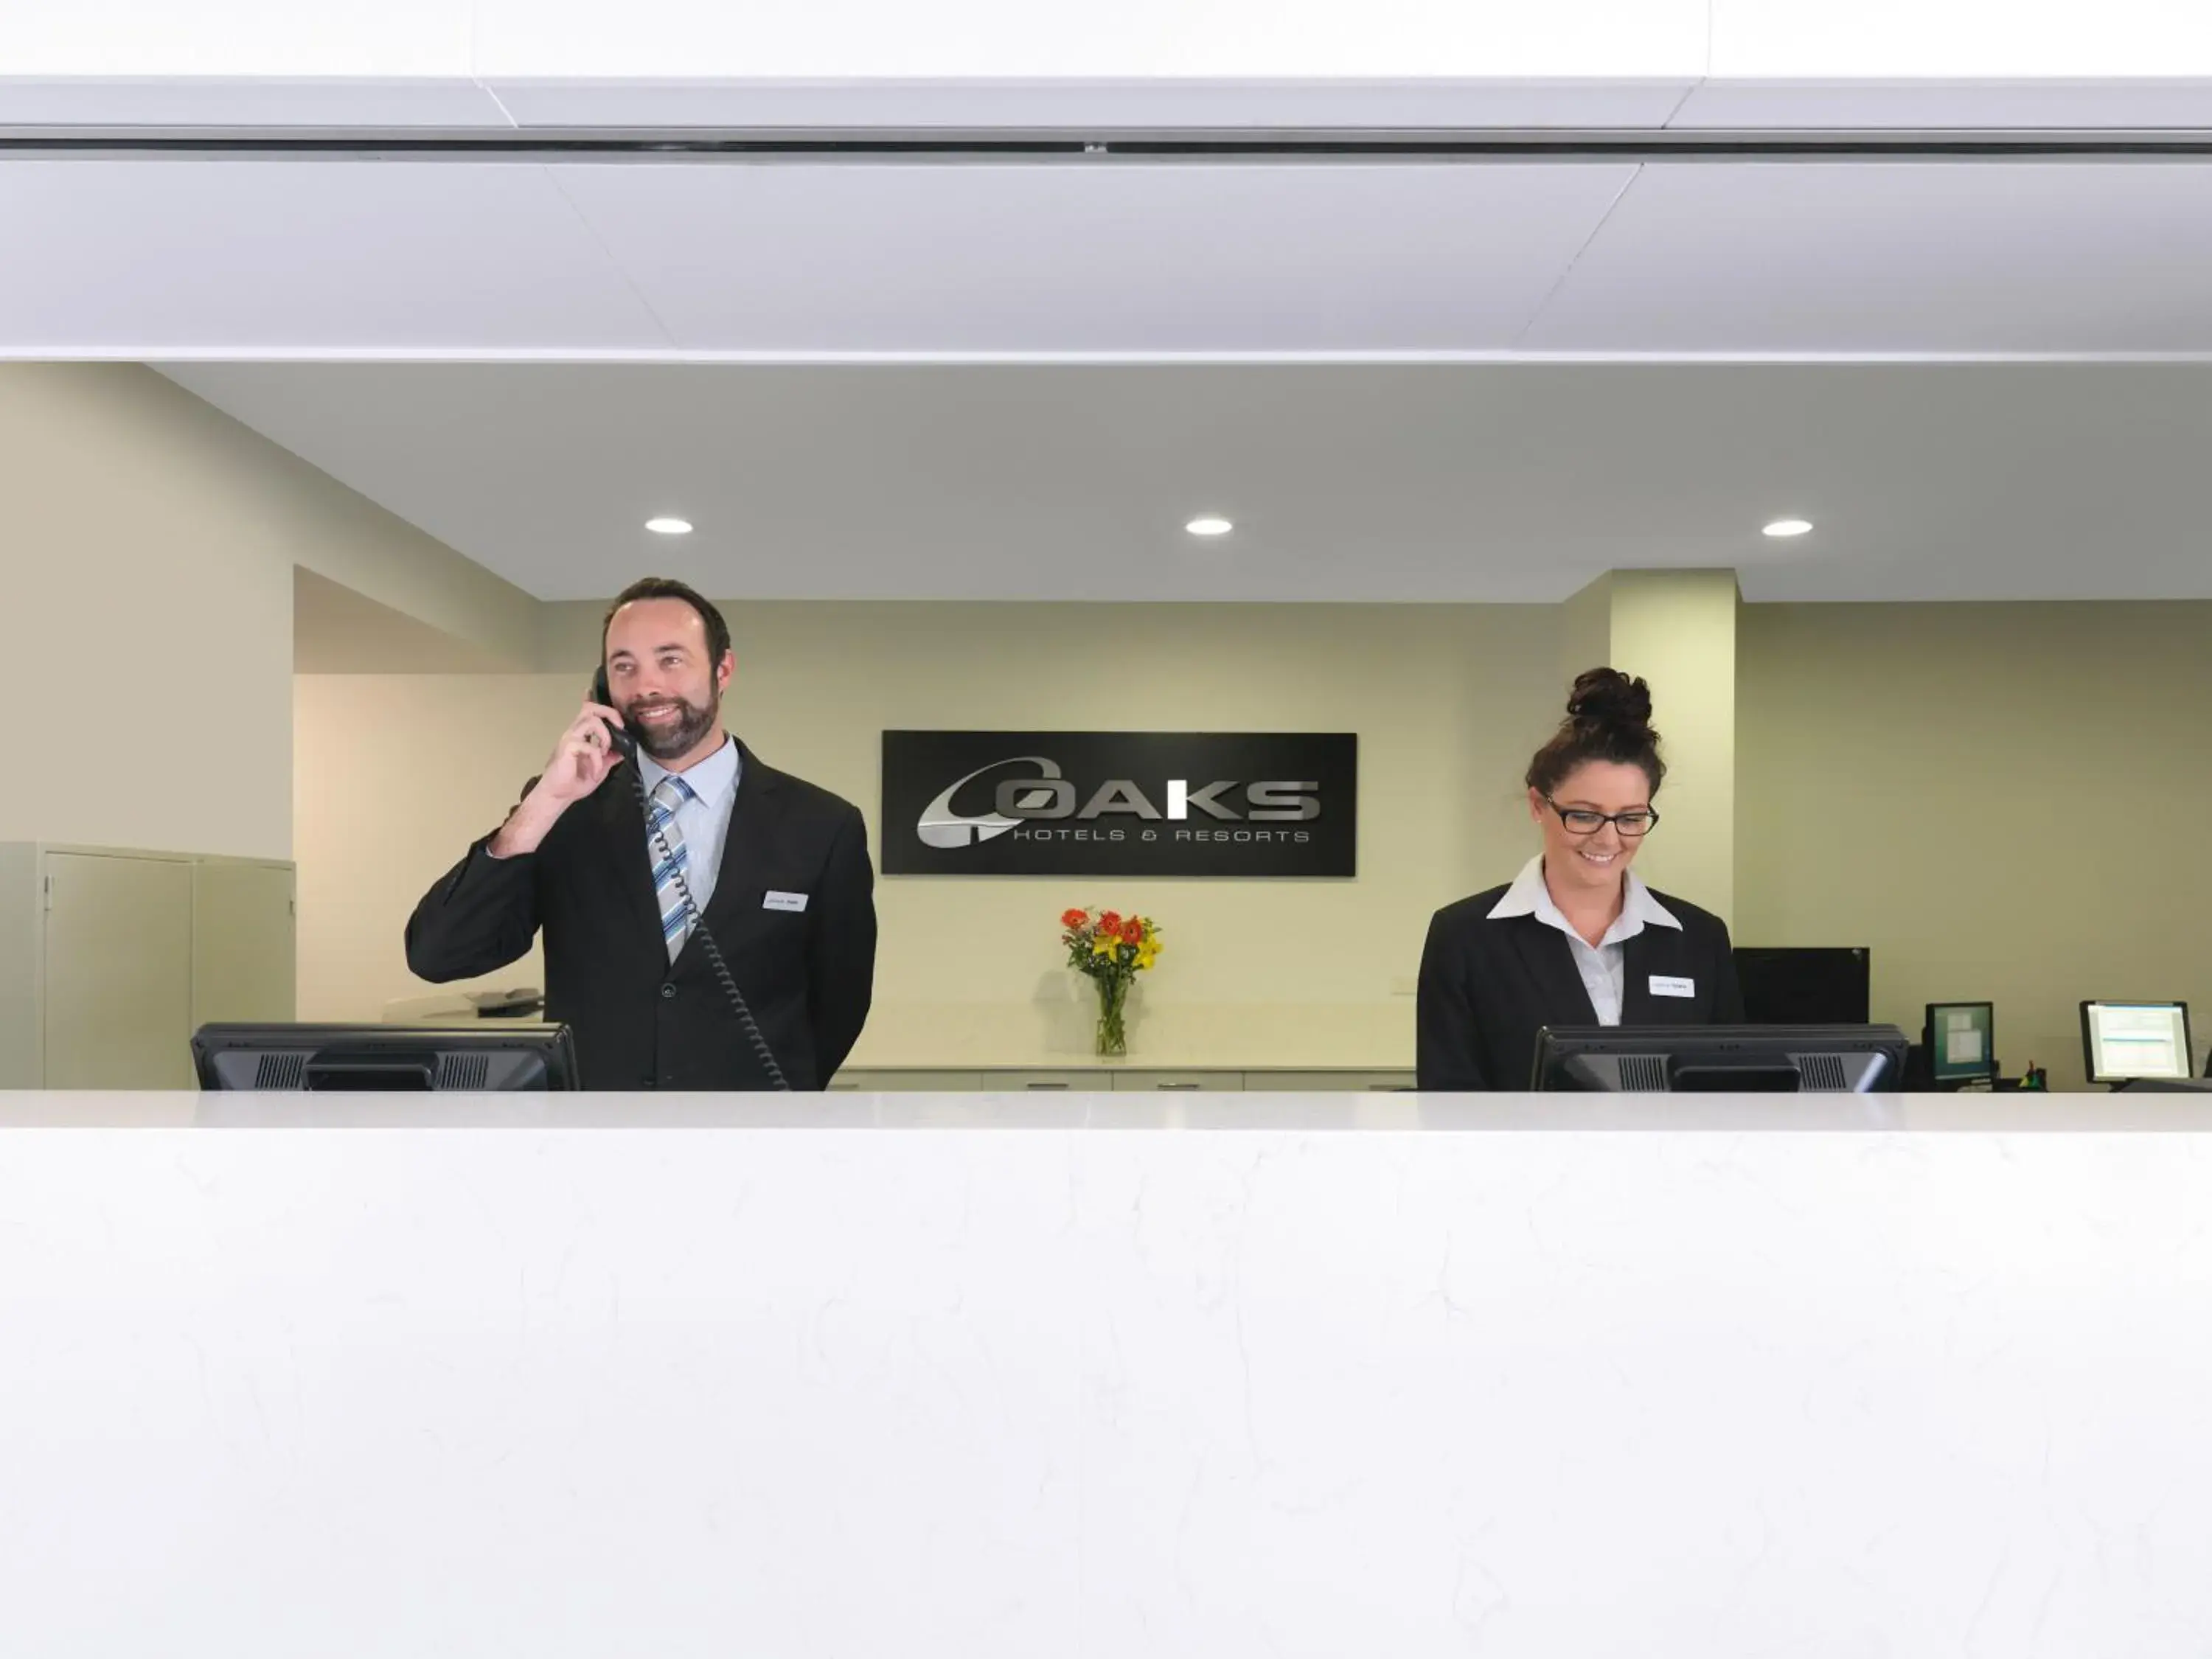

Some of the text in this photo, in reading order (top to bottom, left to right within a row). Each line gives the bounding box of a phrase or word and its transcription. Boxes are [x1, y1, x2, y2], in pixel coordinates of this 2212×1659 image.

[995, 779, 1321, 821] OAKS
[1013, 829, 1310, 843] HOTELS & RESORTS
